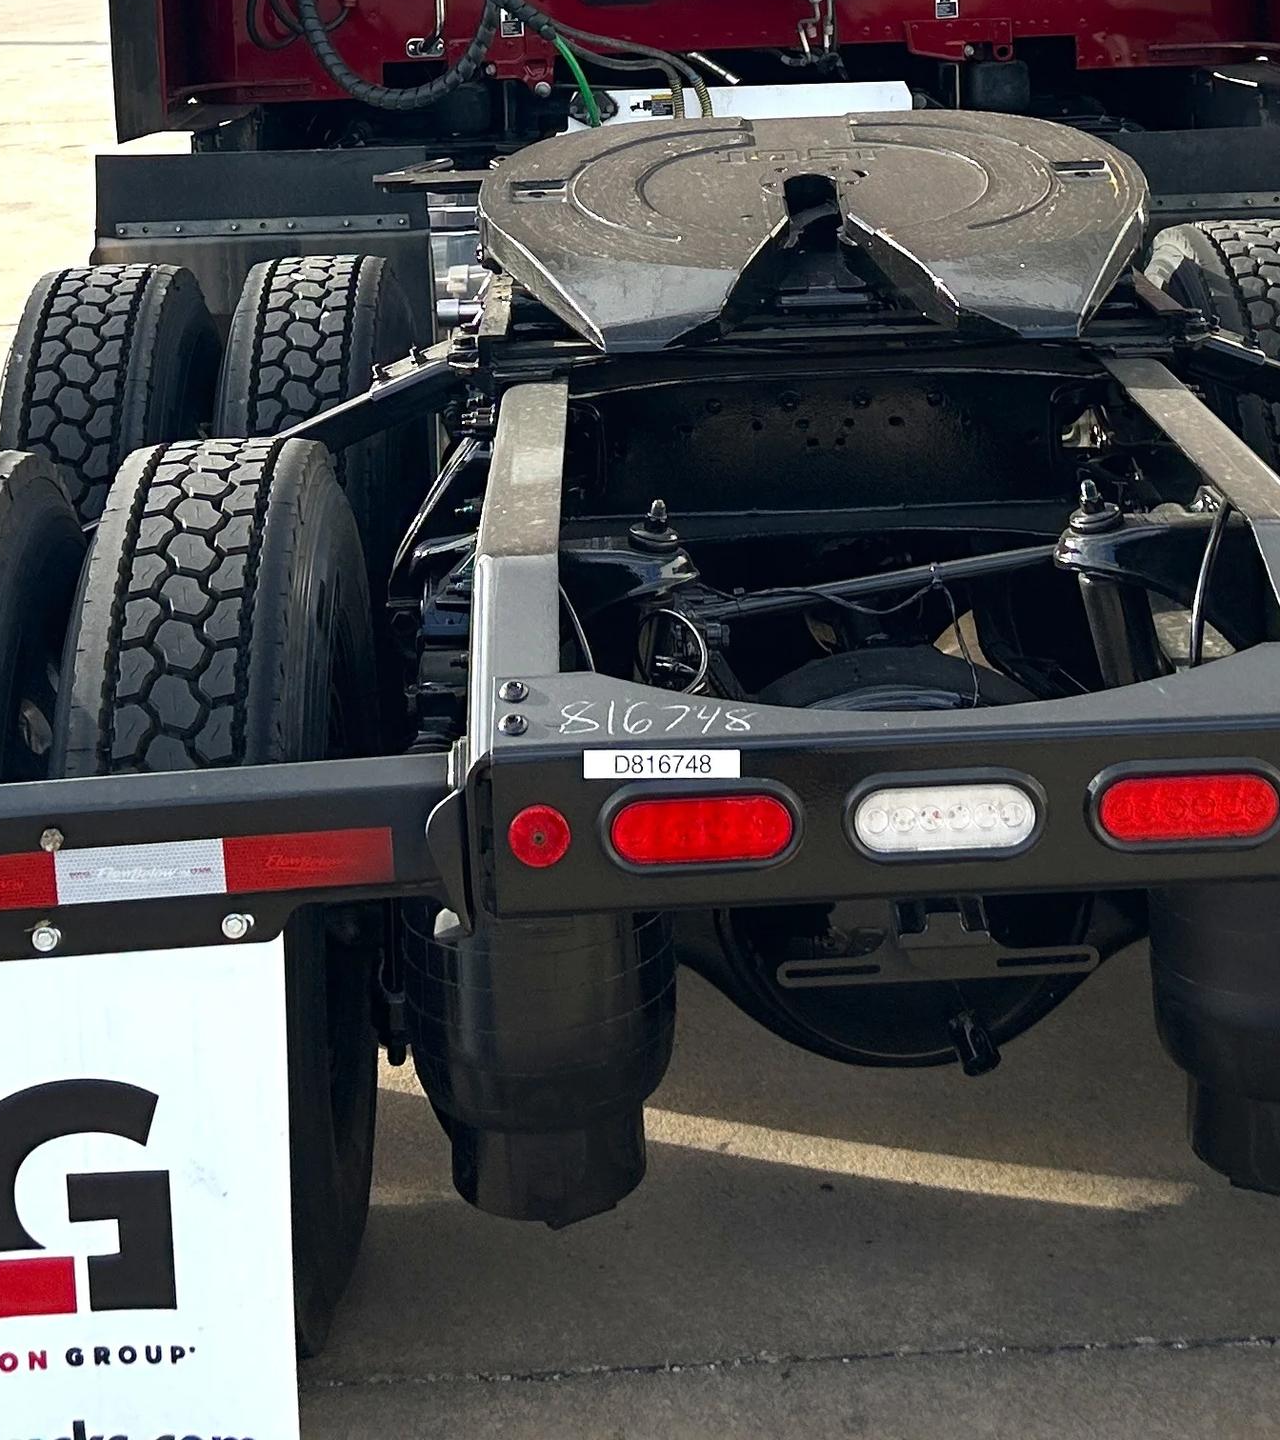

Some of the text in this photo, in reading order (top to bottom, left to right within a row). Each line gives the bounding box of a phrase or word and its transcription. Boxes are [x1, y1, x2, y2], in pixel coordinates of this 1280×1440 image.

[558, 699, 759, 736] 816748
[614, 754, 713, 775] D816748
[65, 1345, 186, 1367] GROUP
